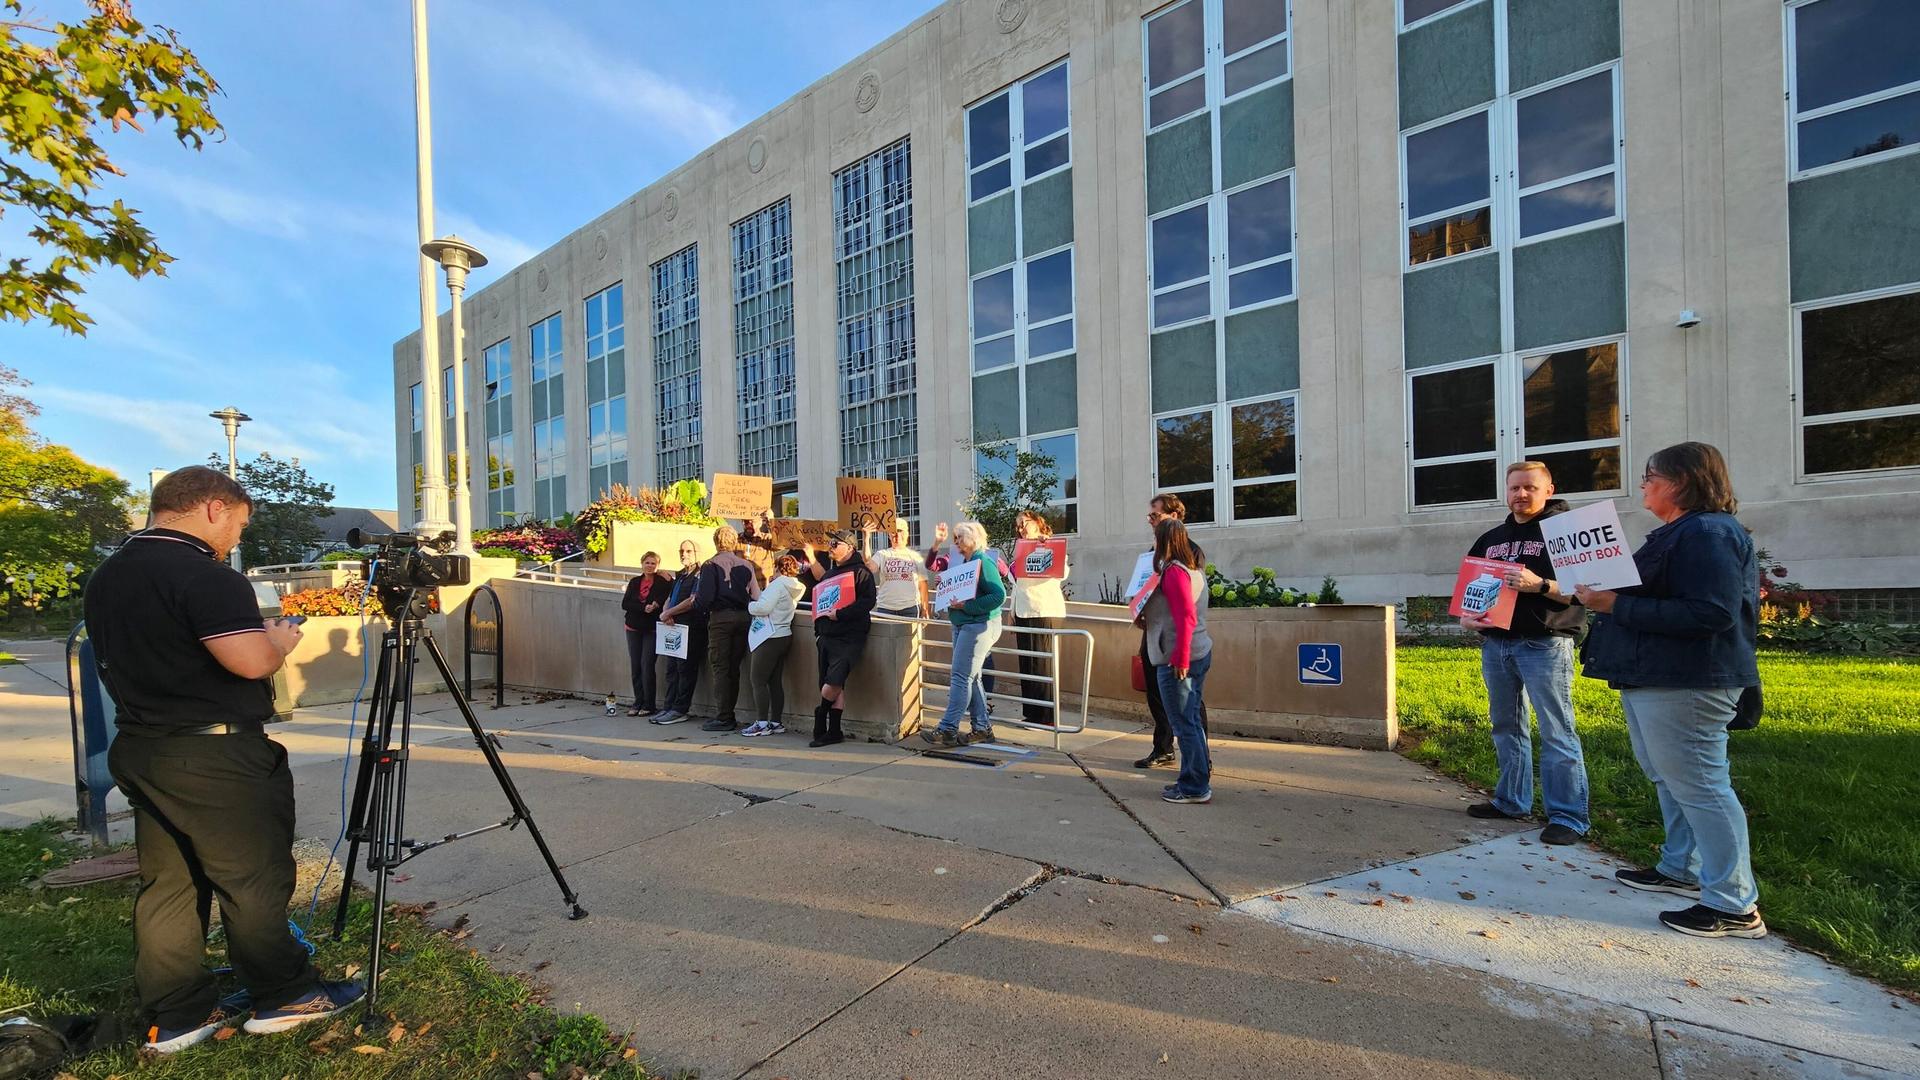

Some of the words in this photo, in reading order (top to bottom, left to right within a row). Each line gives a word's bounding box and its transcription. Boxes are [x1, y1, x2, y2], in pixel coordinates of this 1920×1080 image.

[841, 484, 888, 505] Where's
[860, 504, 873, 512] the
[851, 508, 894, 530] BOX?
[1548, 536, 1568, 556] OUR
[1567, 524, 1617, 551] VOTE
[1552, 556, 1566, 569] OUR
[1564, 550, 1593, 567] BALLOT
[1595, 545, 1623, 560] BOX
[938, 577, 953, 591] OUR
[953, 569, 976, 584] VOTE
[1466, 586, 1486, 599] OUR
[1463, 597, 1483, 610] VOTE
